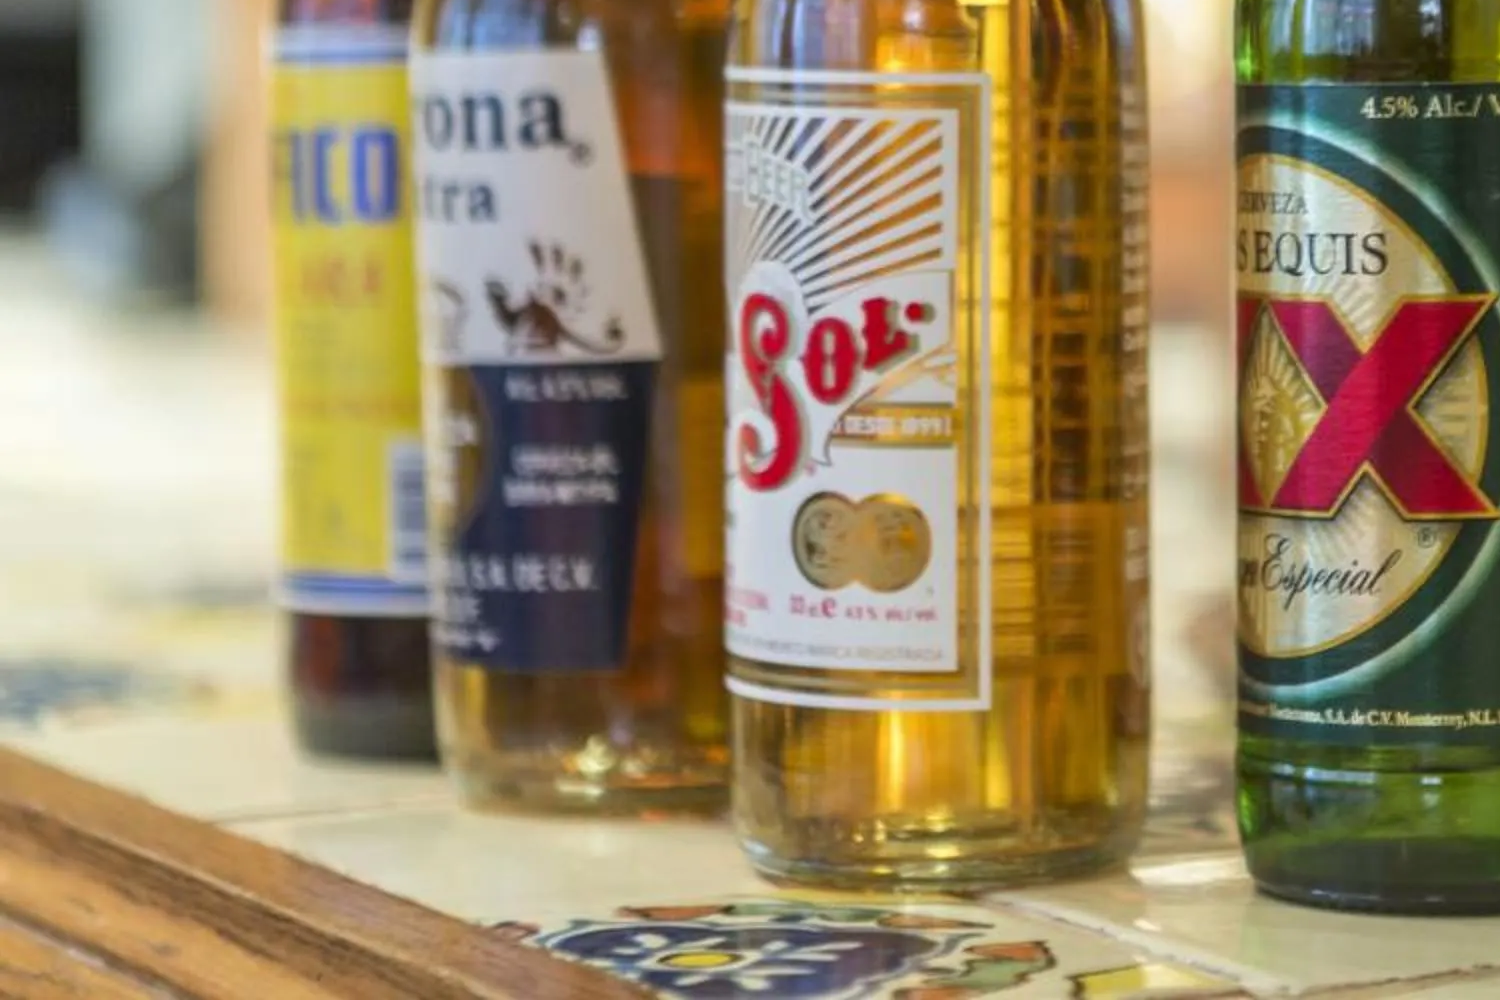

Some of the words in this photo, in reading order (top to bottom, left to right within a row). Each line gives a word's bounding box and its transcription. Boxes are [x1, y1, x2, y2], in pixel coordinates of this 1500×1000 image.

[1359, 96, 1418, 119] 4.5%
[1253, 231, 1389, 277] EQUIS
[1262, 533, 1403, 611] Especial
